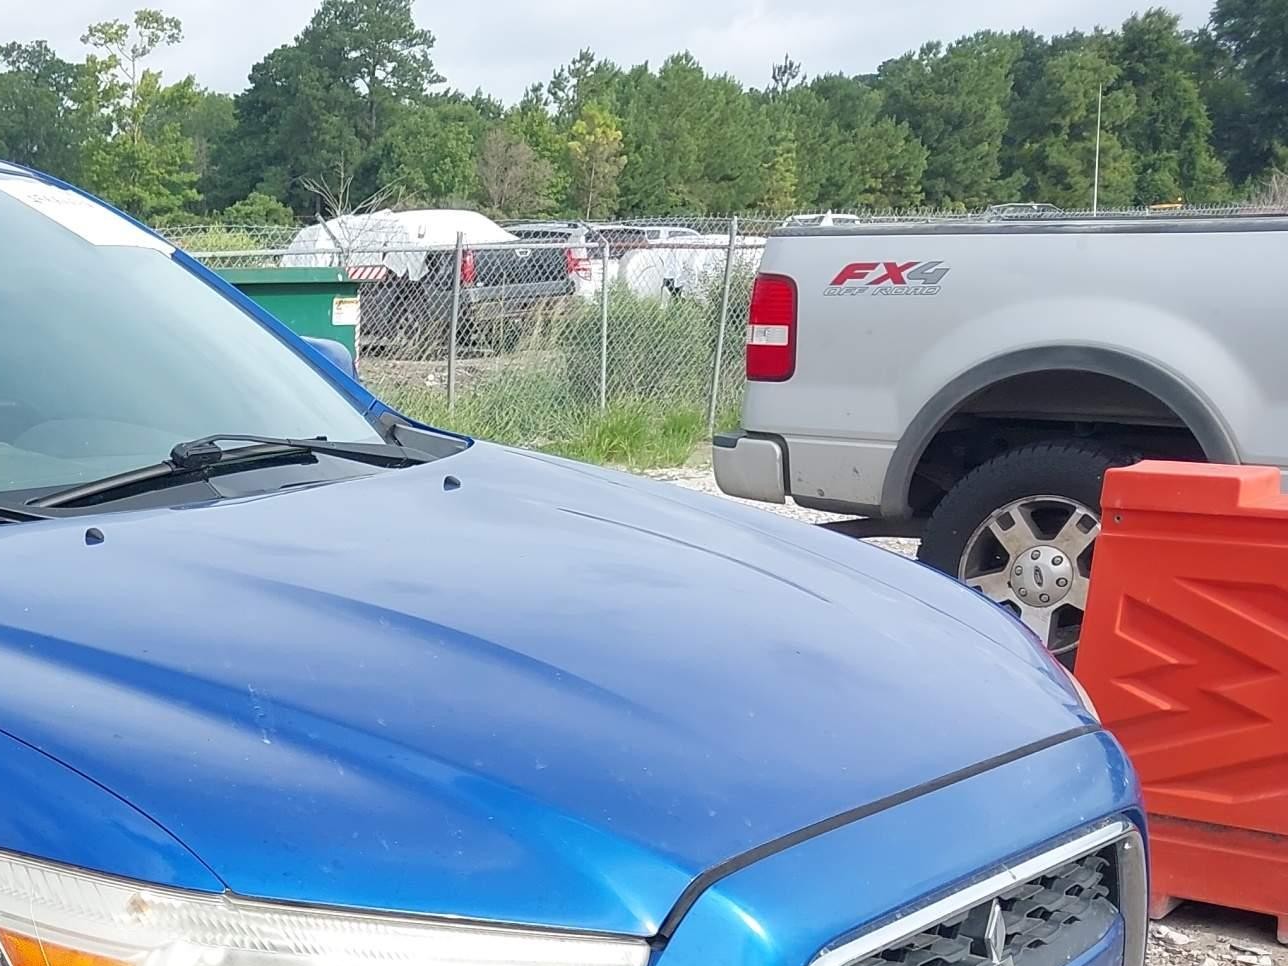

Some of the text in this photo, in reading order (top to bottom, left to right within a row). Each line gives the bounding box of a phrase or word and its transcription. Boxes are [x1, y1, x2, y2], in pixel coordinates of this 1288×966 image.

[828, 260, 952, 286] FX4
[823, 286, 942, 296] OFF ROAD
